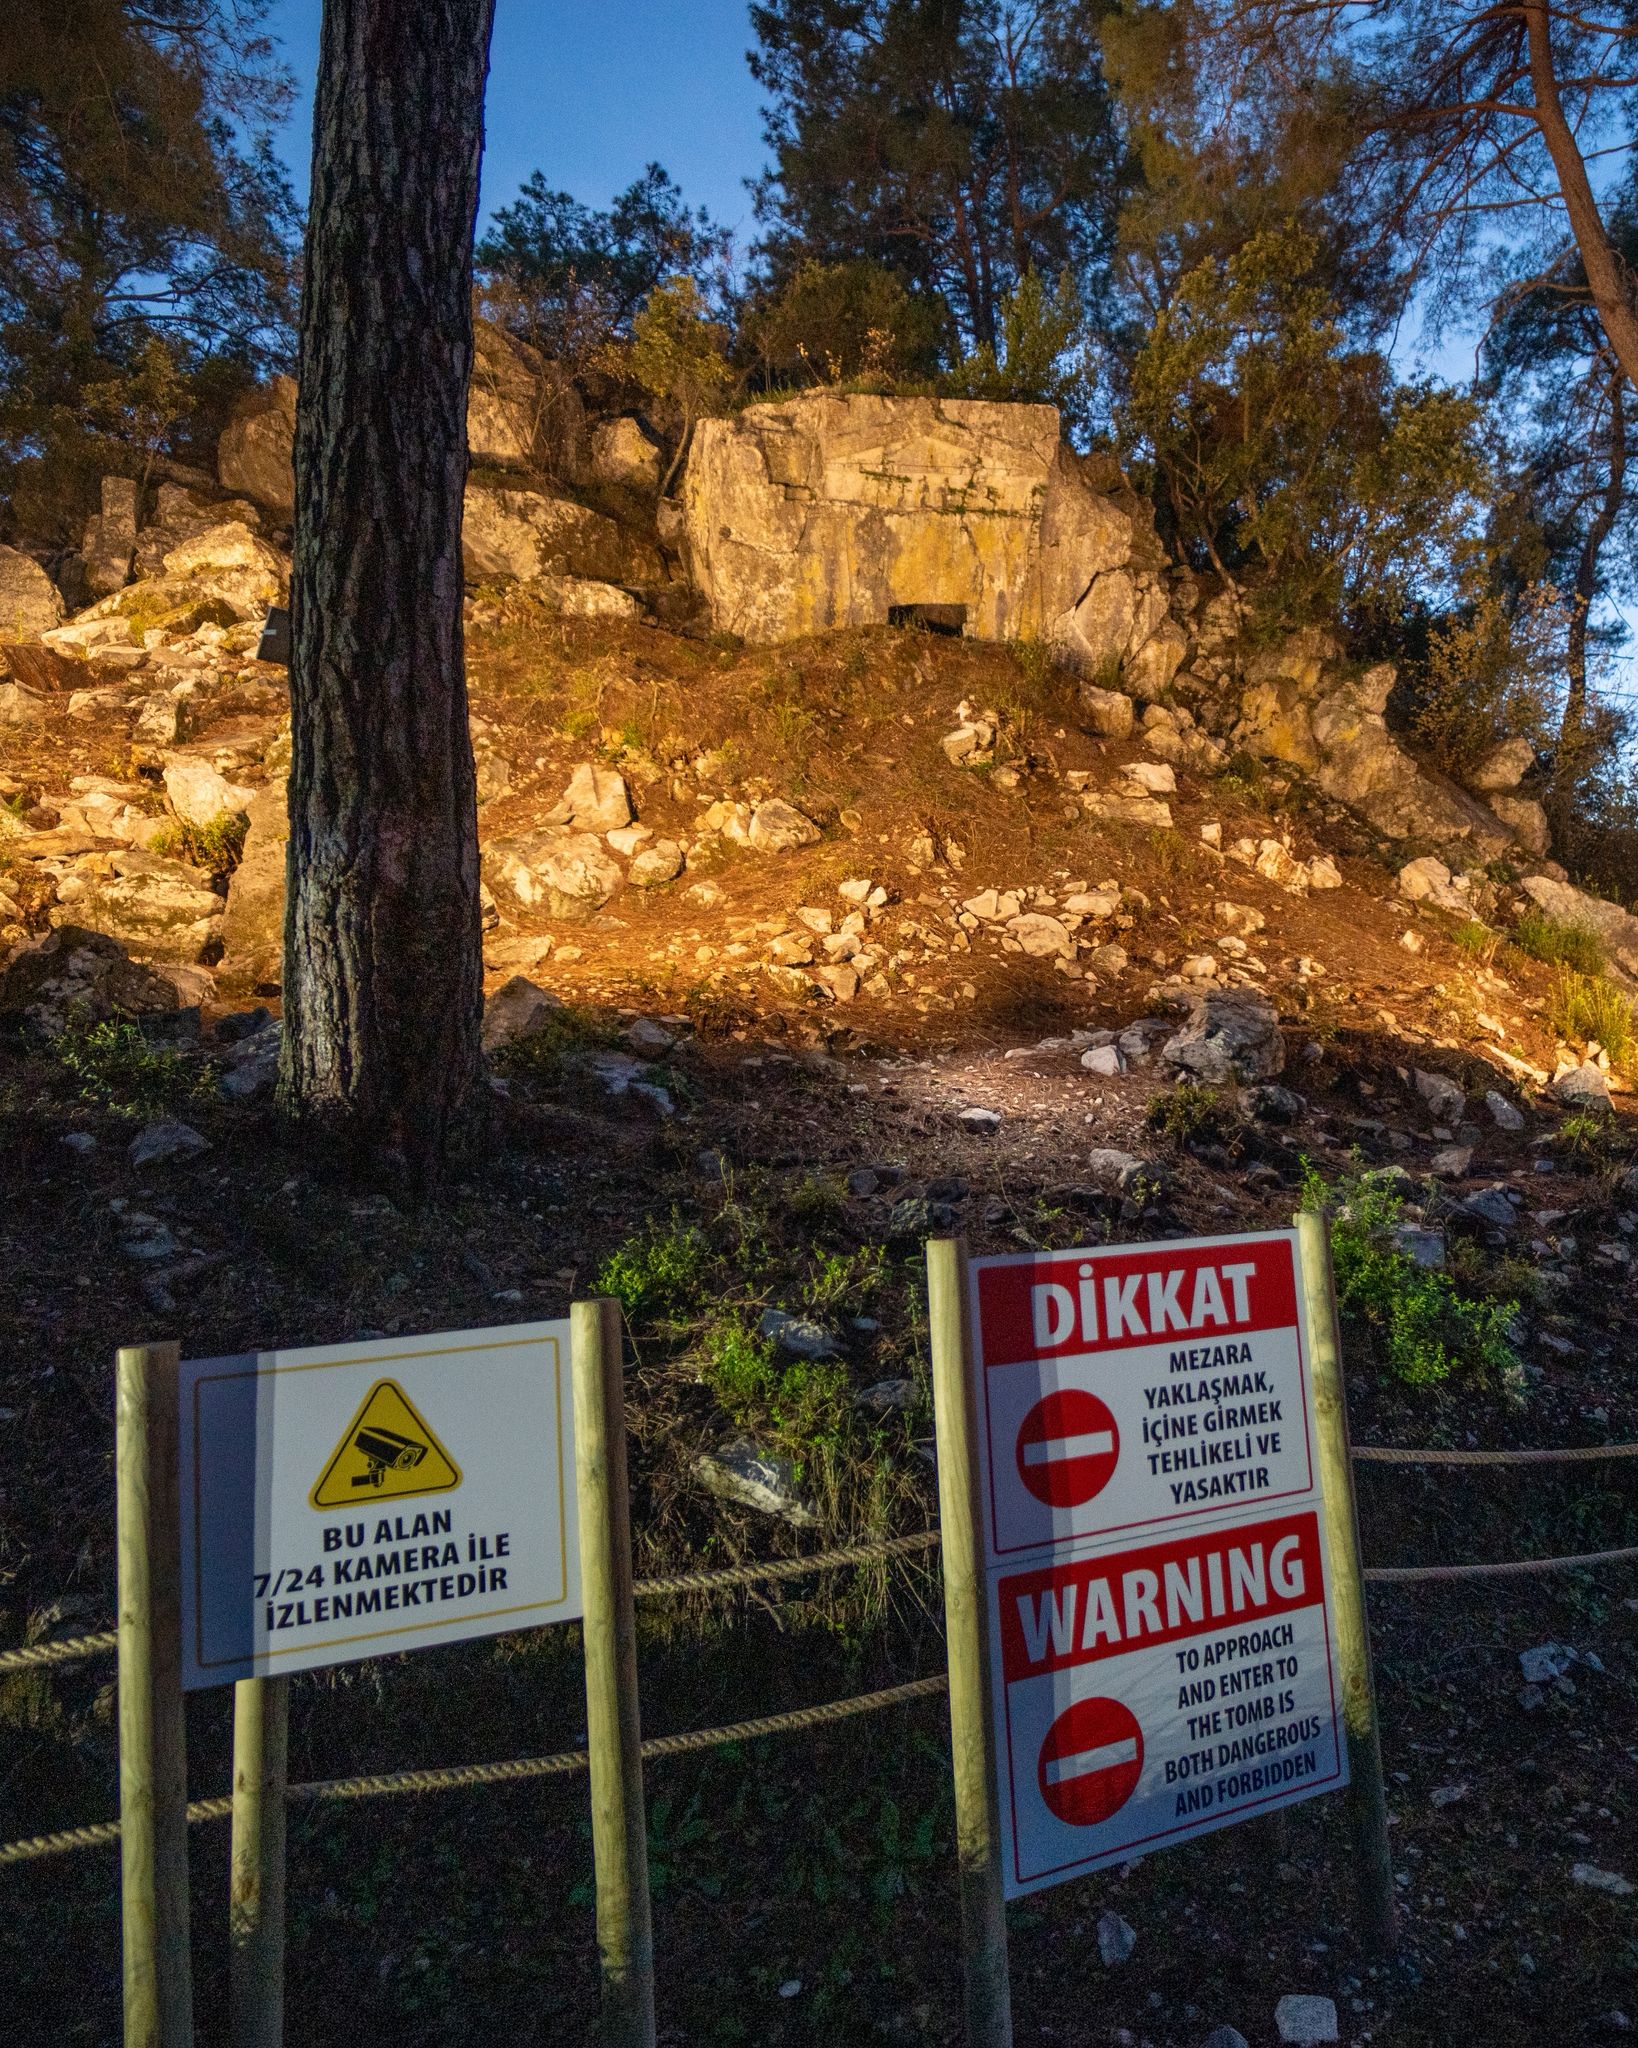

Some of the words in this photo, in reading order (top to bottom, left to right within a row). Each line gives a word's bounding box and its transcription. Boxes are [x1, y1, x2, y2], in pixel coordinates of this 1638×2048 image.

[1032, 1262, 1256, 1349] DİKKAT
[1170, 1342, 1252, 1373] MEZARA
[1144, 1371, 1274, 1409] YAKLAŞMAK,
[1143, 1413, 1198, 1446] İÇİNE
[1203, 1400, 1282, 1433] GİRMEK
[1147, 1437, 1251, 1476] TEHLİKELİ
[1257, 1432, 1281, 1455] VE
[1170, 1466, 1269, 1505] YASAKTIR
[322, 1521, 365, 1552] BU
[374, 1509, 452, 1545] ALAN
[253, 1565, 325, 1599] 7/24
[334, 1541, 460, 1585] KAMERA
[468, 1533, 510, 1562] İLE
[266, 1564, 508, 1631] İZLENMEKTEDİR
[1016, 1535, 1306, 1664] WARNING
[1176, 1650, 1199, 1674] TO
[1203, 1624, 1294, 1667] APPROACH
[1178, 1681, 1215, 1709] AND
[1221, 1665, 1273, 1699] ENTER
[1276, 1656, 1298, 1679] TO
[1187, 1715, 1221, 1741] THE
[1225, 1700, 1275, 1733] TOMB
[1279, 1690, 1295, 1713] IS
[1165, 1751, 1213, 1783] BOTH
[1218, 1716, 1321, 1768] DANGEROUS
[1175, 1786, 1213, 1817] AND
[1218, 1751, 1316, 1800] FORBIDDEN
